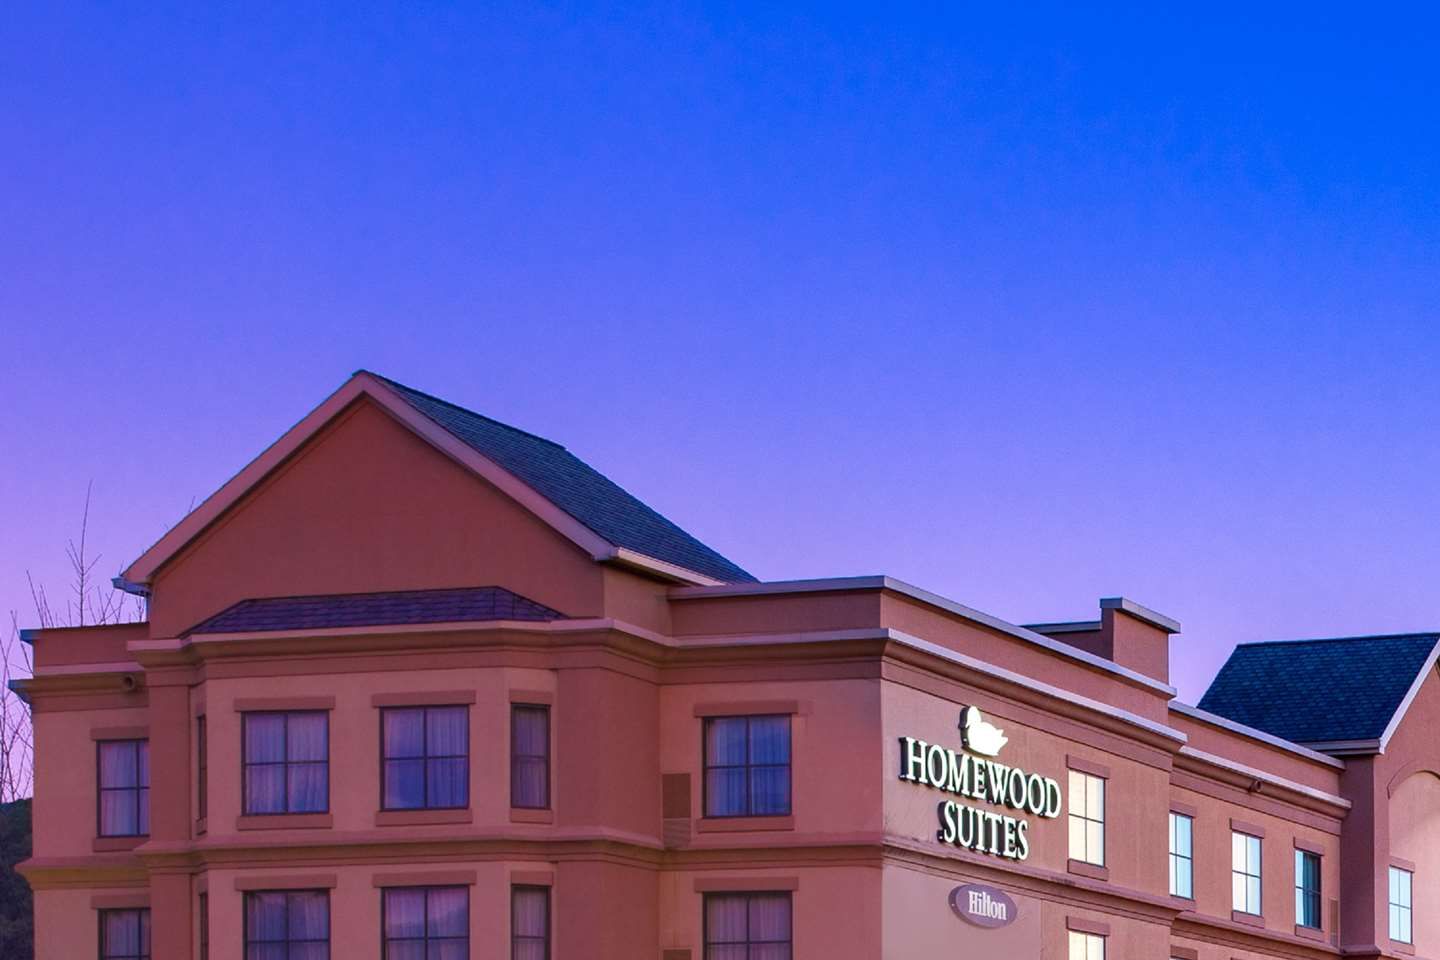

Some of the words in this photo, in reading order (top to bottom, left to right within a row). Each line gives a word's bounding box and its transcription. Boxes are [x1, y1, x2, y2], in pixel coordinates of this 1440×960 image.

[899, 737, 1062, 818] HOMEWOOD
[938, 801, 1030, 860] SUITES
[968, 890, 1007, 920] Hilton
